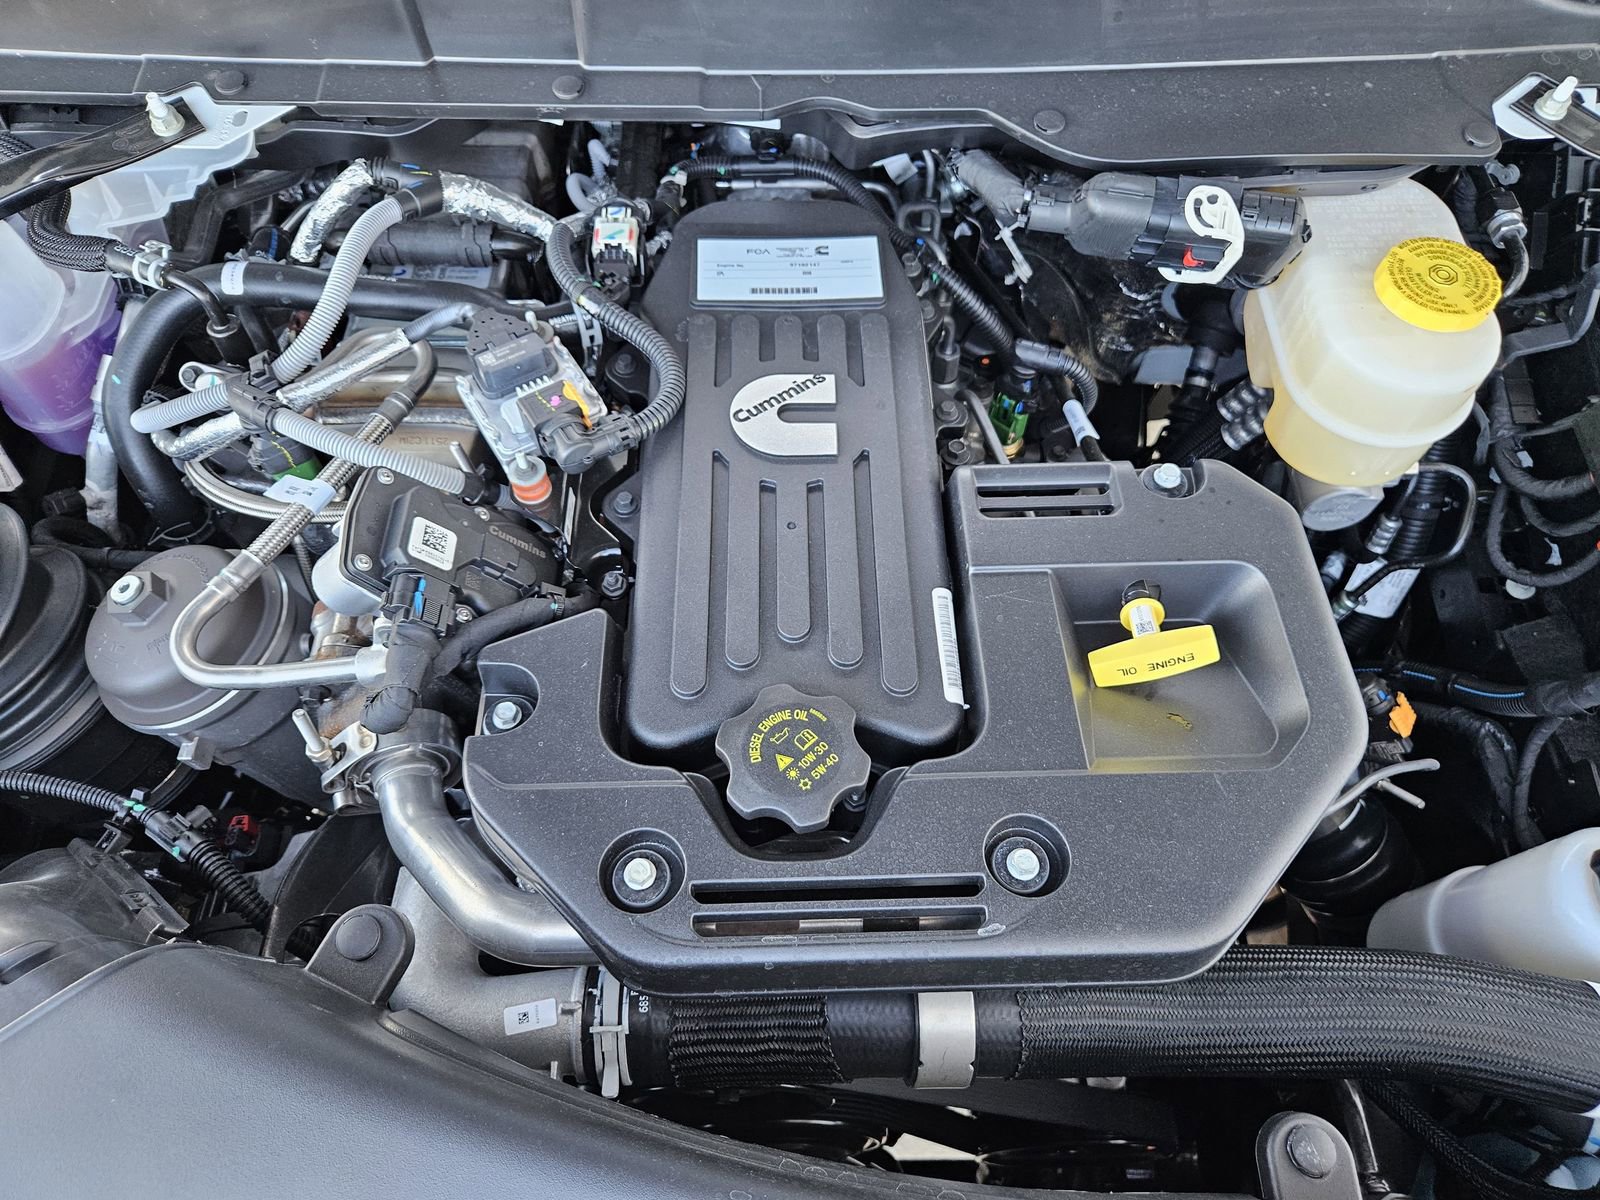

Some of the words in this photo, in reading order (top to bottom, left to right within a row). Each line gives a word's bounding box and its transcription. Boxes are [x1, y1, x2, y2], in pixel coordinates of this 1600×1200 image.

[733, 374, 826, 423] Cummins
[489, 525, 547, 559] Cummins
[1116, 666, 1137, 677] OIL
[1148, 652, 1195, 672] ENGINE
[749, 732, 765, 763] DIESEL
[758, 709, 792, 733] ENGINE
[793, 709, 809, 721] OIL
[798, 741, 829, 769] 10W-30
[810, 753, 840, 780] 5W-40
